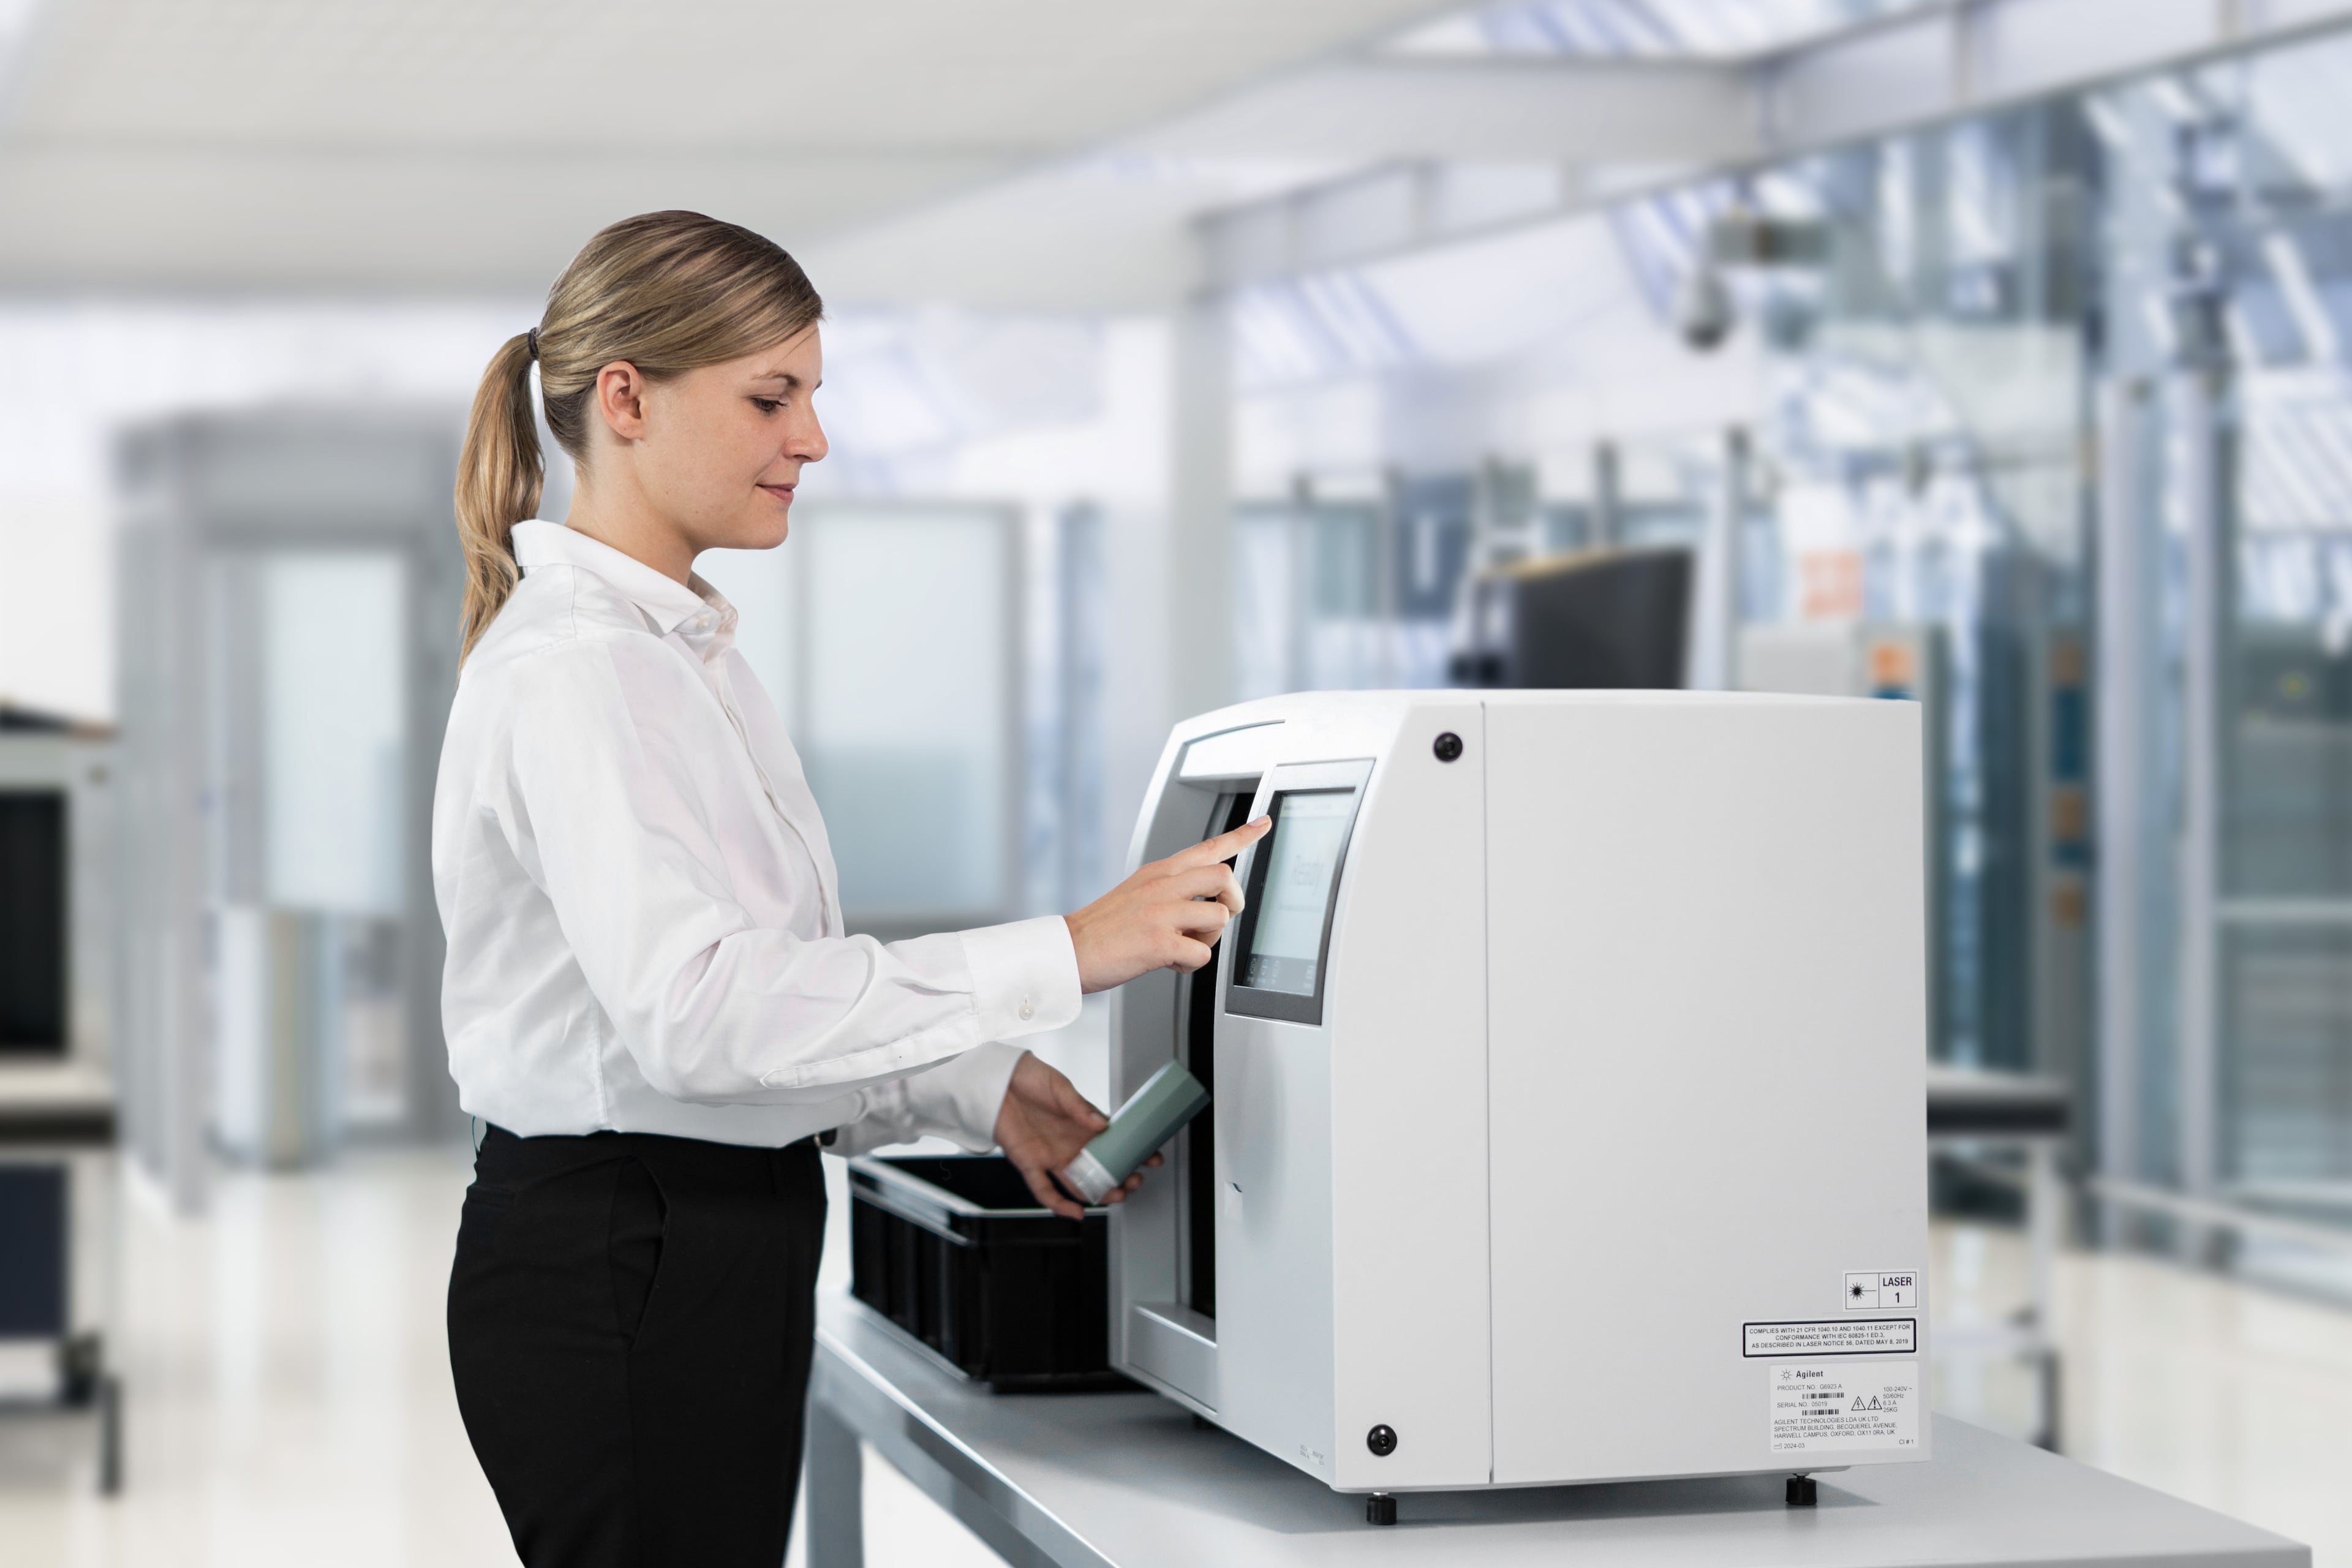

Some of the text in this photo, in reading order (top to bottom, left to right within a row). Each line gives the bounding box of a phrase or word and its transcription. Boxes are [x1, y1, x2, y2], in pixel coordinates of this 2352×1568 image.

[1883, 1276, 1912, 1286] LASER
[1895, 1292, 1900, 1303] 1
[1796, 1370, 1823, 1379] Agilent
